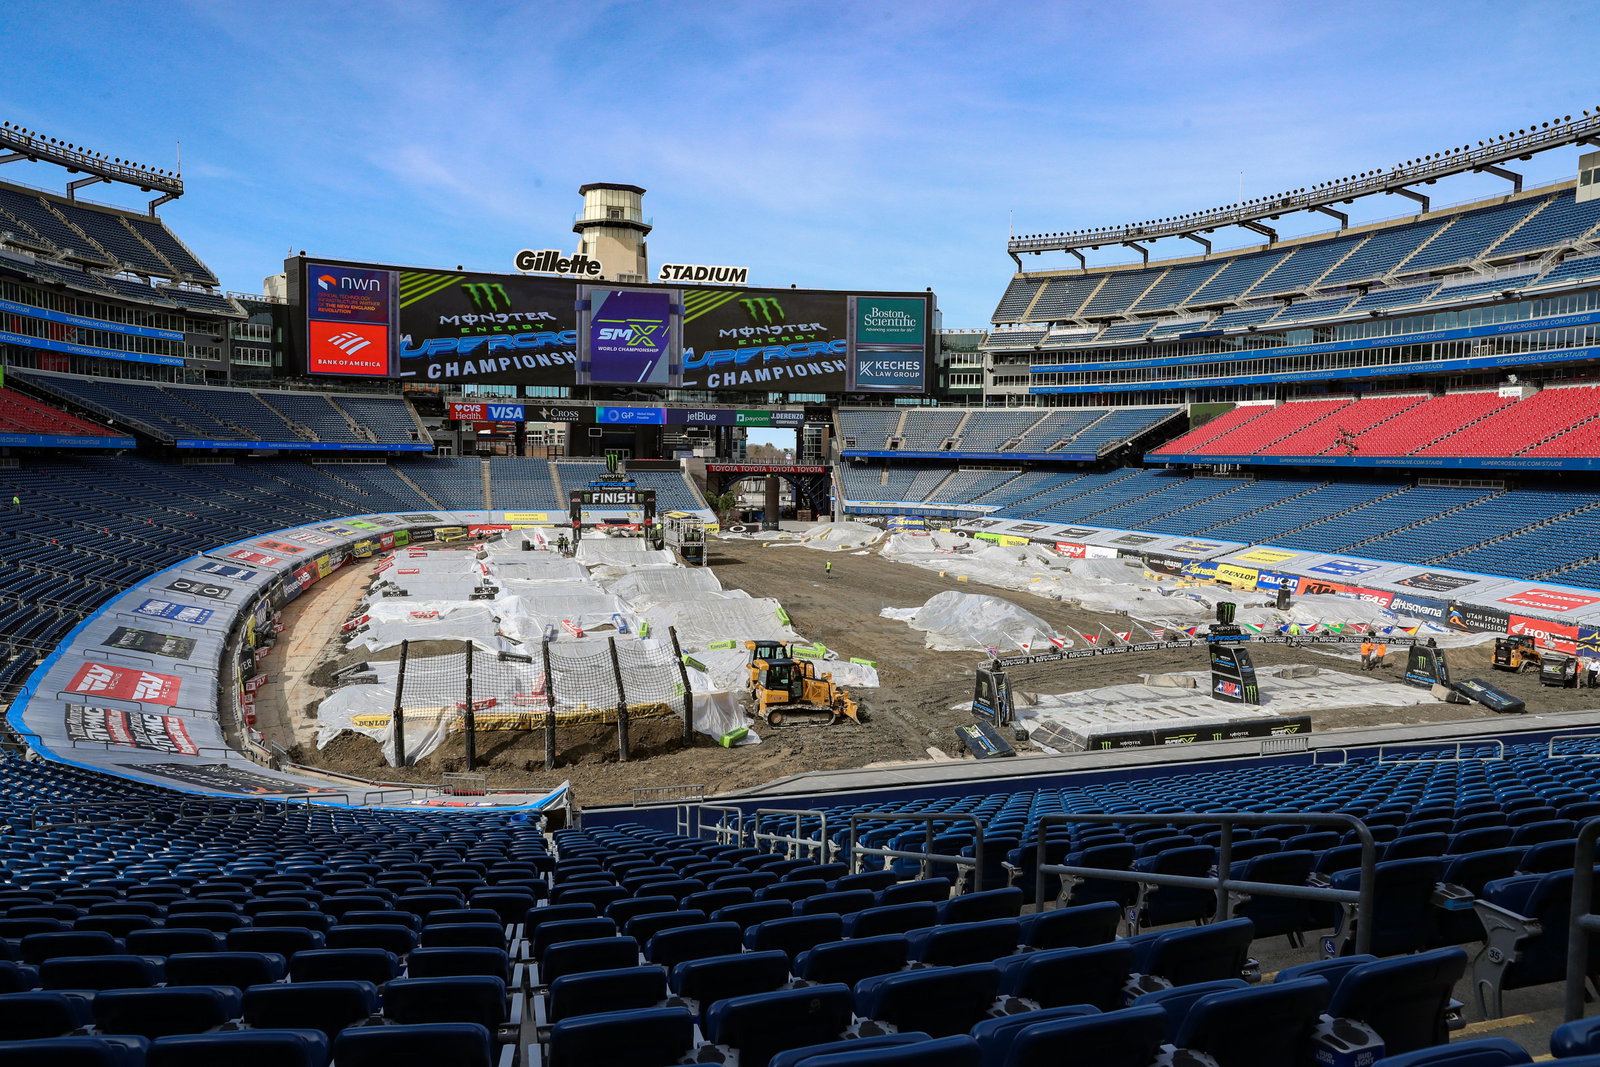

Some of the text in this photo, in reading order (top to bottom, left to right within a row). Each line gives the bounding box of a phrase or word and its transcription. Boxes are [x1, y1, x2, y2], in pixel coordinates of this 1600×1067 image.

[516, 250, 601, 275] Gillette
[660, 264, 748, 282] STADIUM
[342, 276, 380, 291] nwn
[872, 307, 904, 318] Boston
[439, 312, 557, 326] MONSTER
[864, 314, 916, 326] Scientific
[1498, 315, 1590, 332] SUPERCROSSLIVE.COM/STJUDE
[461, 323, 546, 334] ENERGY
[719, 322, 828, 338] MONSTER
[597, 324, 658, 346] SMX
[738, 334, 816, 345] ENERGY
[1372, 333, 1446, 345] SUPERCROSSLIVE.COM/STJUDE
[1496, 351, 1588, 364] SUPERCROSSLIVE.COM/STJUDE
[875, 361, 920, 370] KECHES
[1370, 364, 1444, 374] SUPERCROSSLIVE.COM/STJUDE
[489, 407, 523, 419] VISA
[686, 412, 716, 422] jetBlue
[592, 492, 635, 503] FINISH
[1222, 569, 1256, 581] DUNLOP
[1304, 583, 1336, 595] KTM
[1399, 598, 1442, 618] Husqvarna
[1466, 620, 1507, 633] COMMISSION
[1484, 615, 1508, 626] SPORTS
[1524, 627, 1575, 645] HONDA
[1490, 950, 1500, 960] 35
